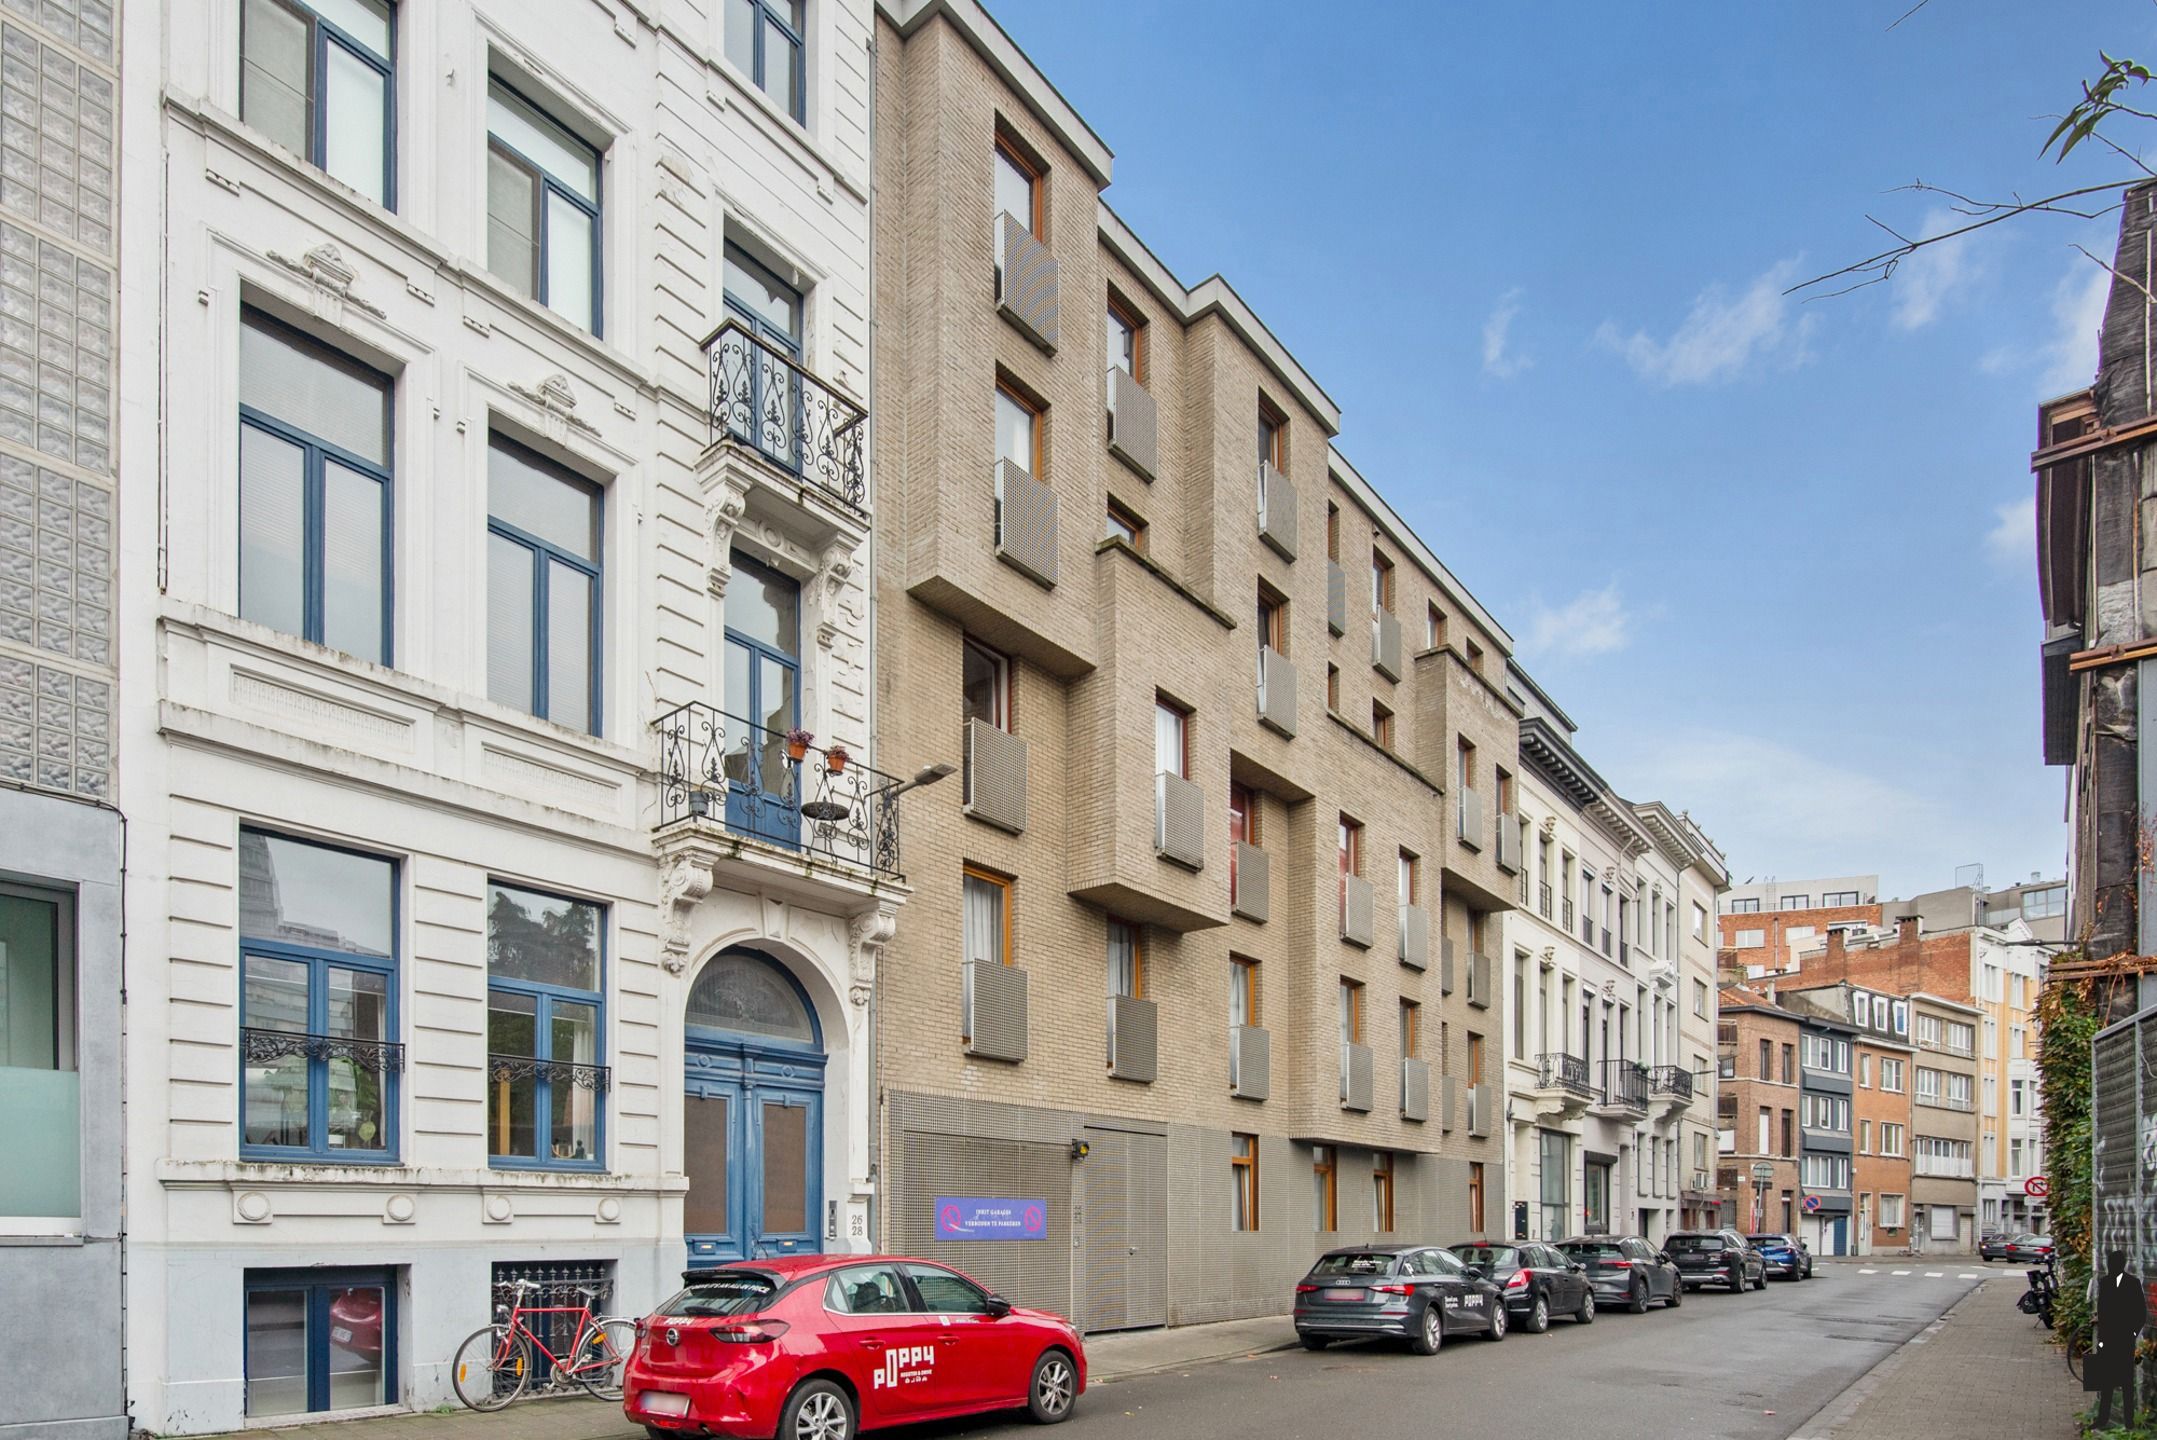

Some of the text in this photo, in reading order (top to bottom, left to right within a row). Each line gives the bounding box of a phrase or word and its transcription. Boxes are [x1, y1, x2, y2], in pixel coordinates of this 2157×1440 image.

[851, 1214, 863, 1225] 26
[851, 1225, 863, 1236] 28
[1464, 1294, 1484, 1308] POPPY
[873, 1346, 934, 1389] POPPY
